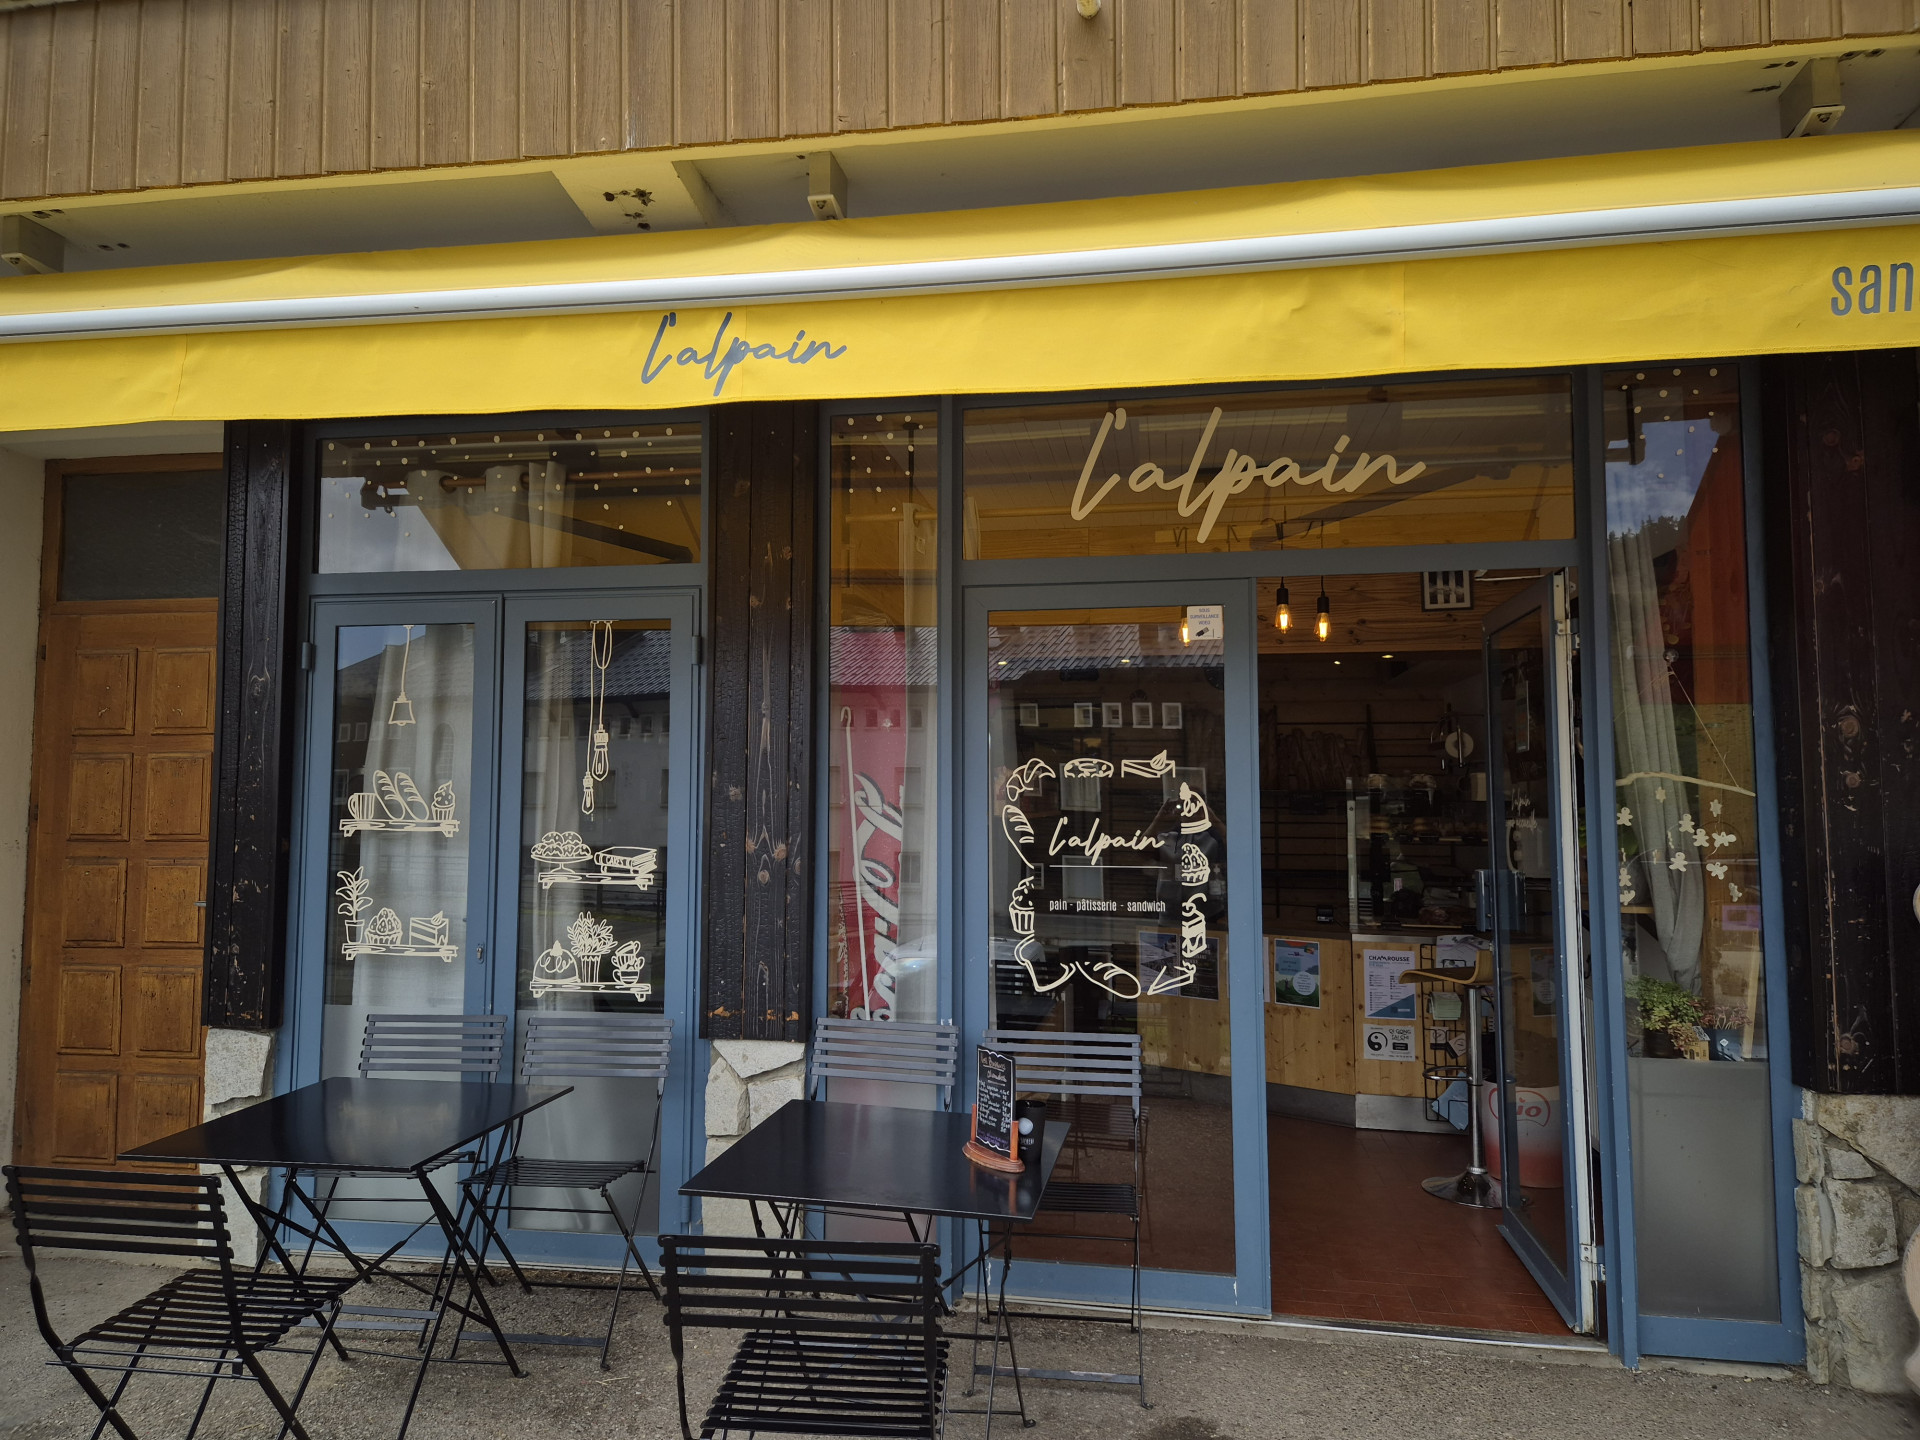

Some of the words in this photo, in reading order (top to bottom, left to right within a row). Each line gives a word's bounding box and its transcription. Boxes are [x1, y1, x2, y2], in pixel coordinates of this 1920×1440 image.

[1049, 899, 1068, 912] pain
[1076, 898, 1117, 912] pâtisserie
[1127, 900, 1166, 912] sandwich
